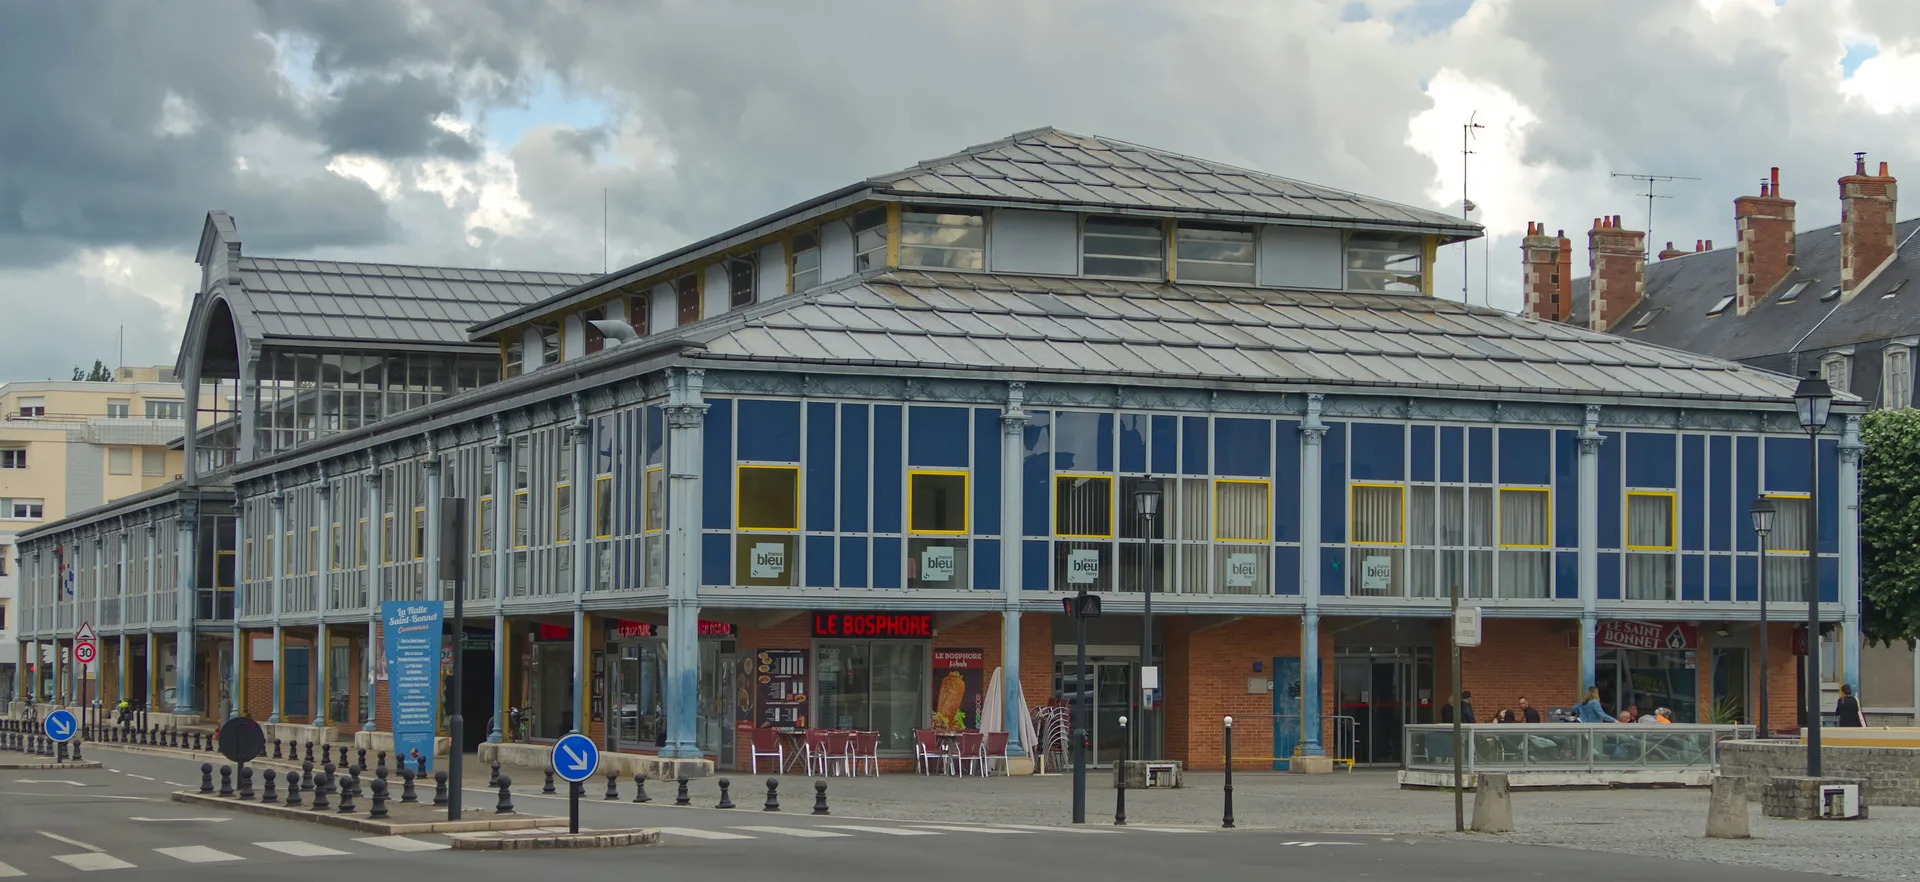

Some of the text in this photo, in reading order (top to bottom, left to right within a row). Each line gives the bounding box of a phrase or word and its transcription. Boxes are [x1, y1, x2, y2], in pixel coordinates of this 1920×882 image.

[757, 553, 783, 566] bleu
[928, 556, 953, 569] bleu
[1073, 559, 1098, 572] bleu
[1232, 563, 1256, 575] bleu
[1367, 565, 1390, 578] bleu
[397, 605, 428, 618] La Halle
[389, 613, 438, 626] Saint-Bonnet
[815, 614, 931, 637] LE BOSPHORE
[1624, 623, 1663, 638] SAINT
[1605, 630, 1661, 648] BONNET
[79, 648, 92, 657] 30
